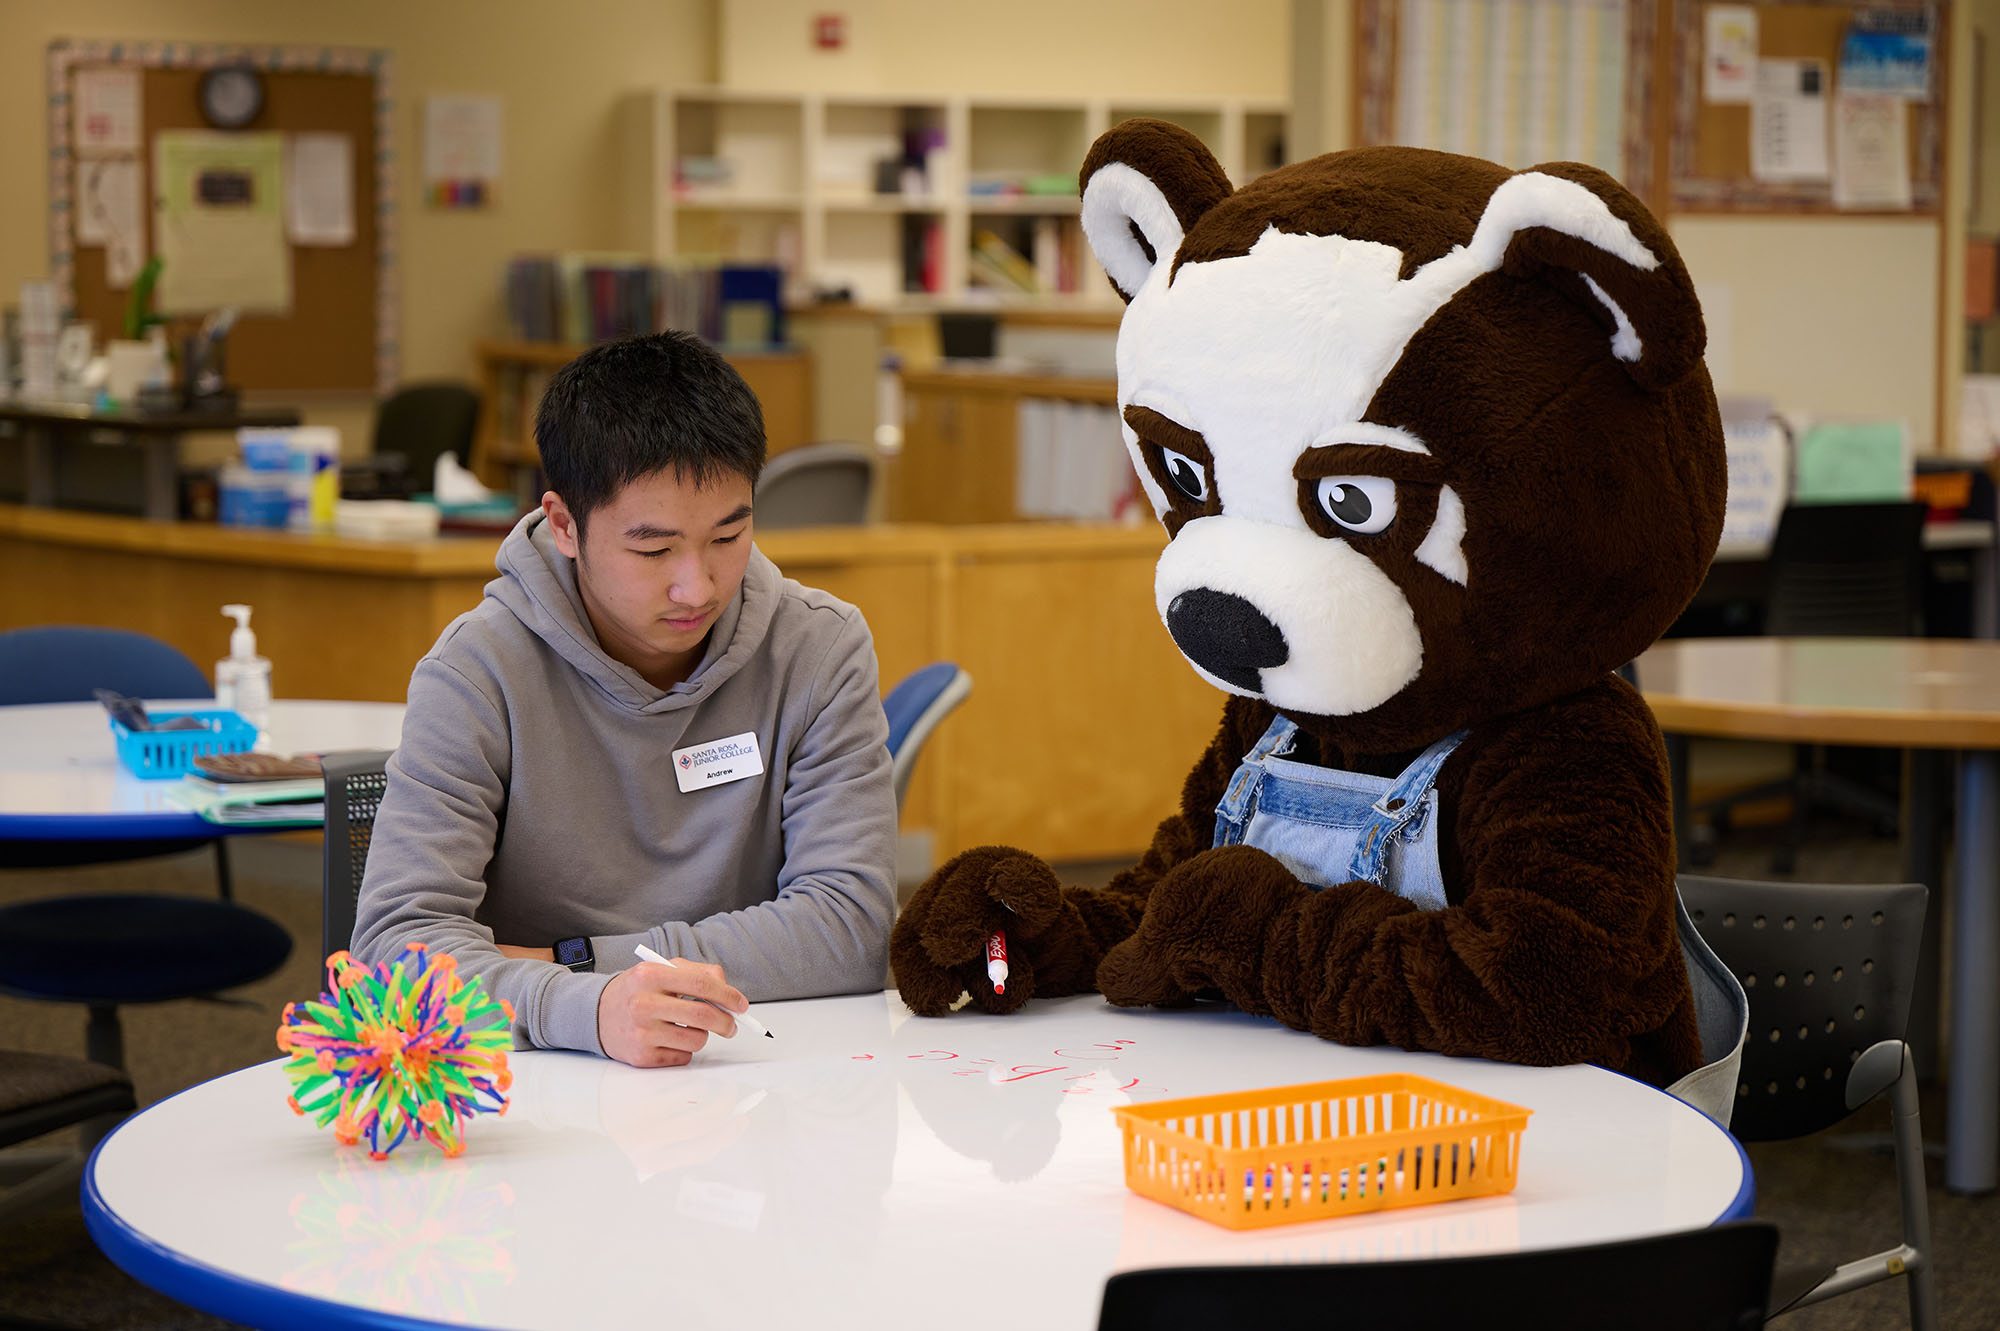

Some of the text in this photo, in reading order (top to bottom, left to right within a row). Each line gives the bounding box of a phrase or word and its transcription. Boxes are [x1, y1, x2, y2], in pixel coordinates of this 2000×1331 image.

[692, 743, 739, 759] SANTA ROSA
[694, 745, 753, 768] JUNIOR COLLEGE
[706, 768, 734, 779] Andrew
